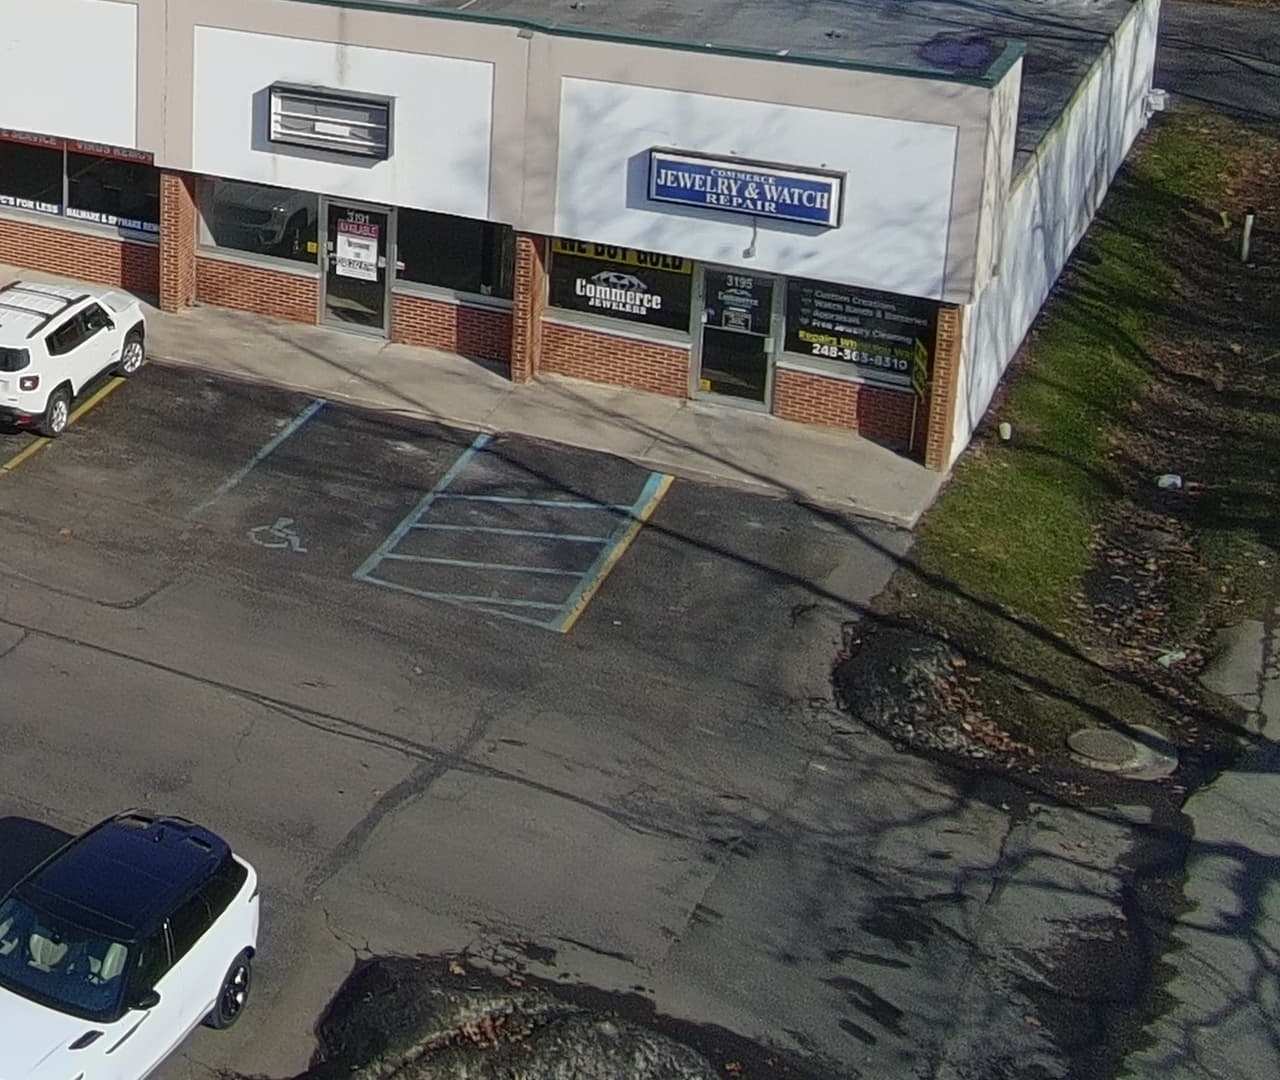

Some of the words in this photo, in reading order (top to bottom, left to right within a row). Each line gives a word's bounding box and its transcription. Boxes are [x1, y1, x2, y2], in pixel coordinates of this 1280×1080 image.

[710, 168, 777, 184] COMMERCE
[657, 169, 741, 196] JEWELRY
[744, 182, 760, 199] &
[763, 185, 829, 210] WATCH
[16, 197, 34, 210] FOR
[36, 201, 59, 214] LESS
[706, 193, 777, 213] REPAIR
[560, 239, 587, 254] WE
[594, 243, 628, 260] BUY
[637, 249, 684, 269] GOLD
[726, 274, 753, 290] 3195
[575, 277, 662, 309] Commerce
[589, 298, 647, 315] JEWELERS
[812, 320, 833, 330] Free
